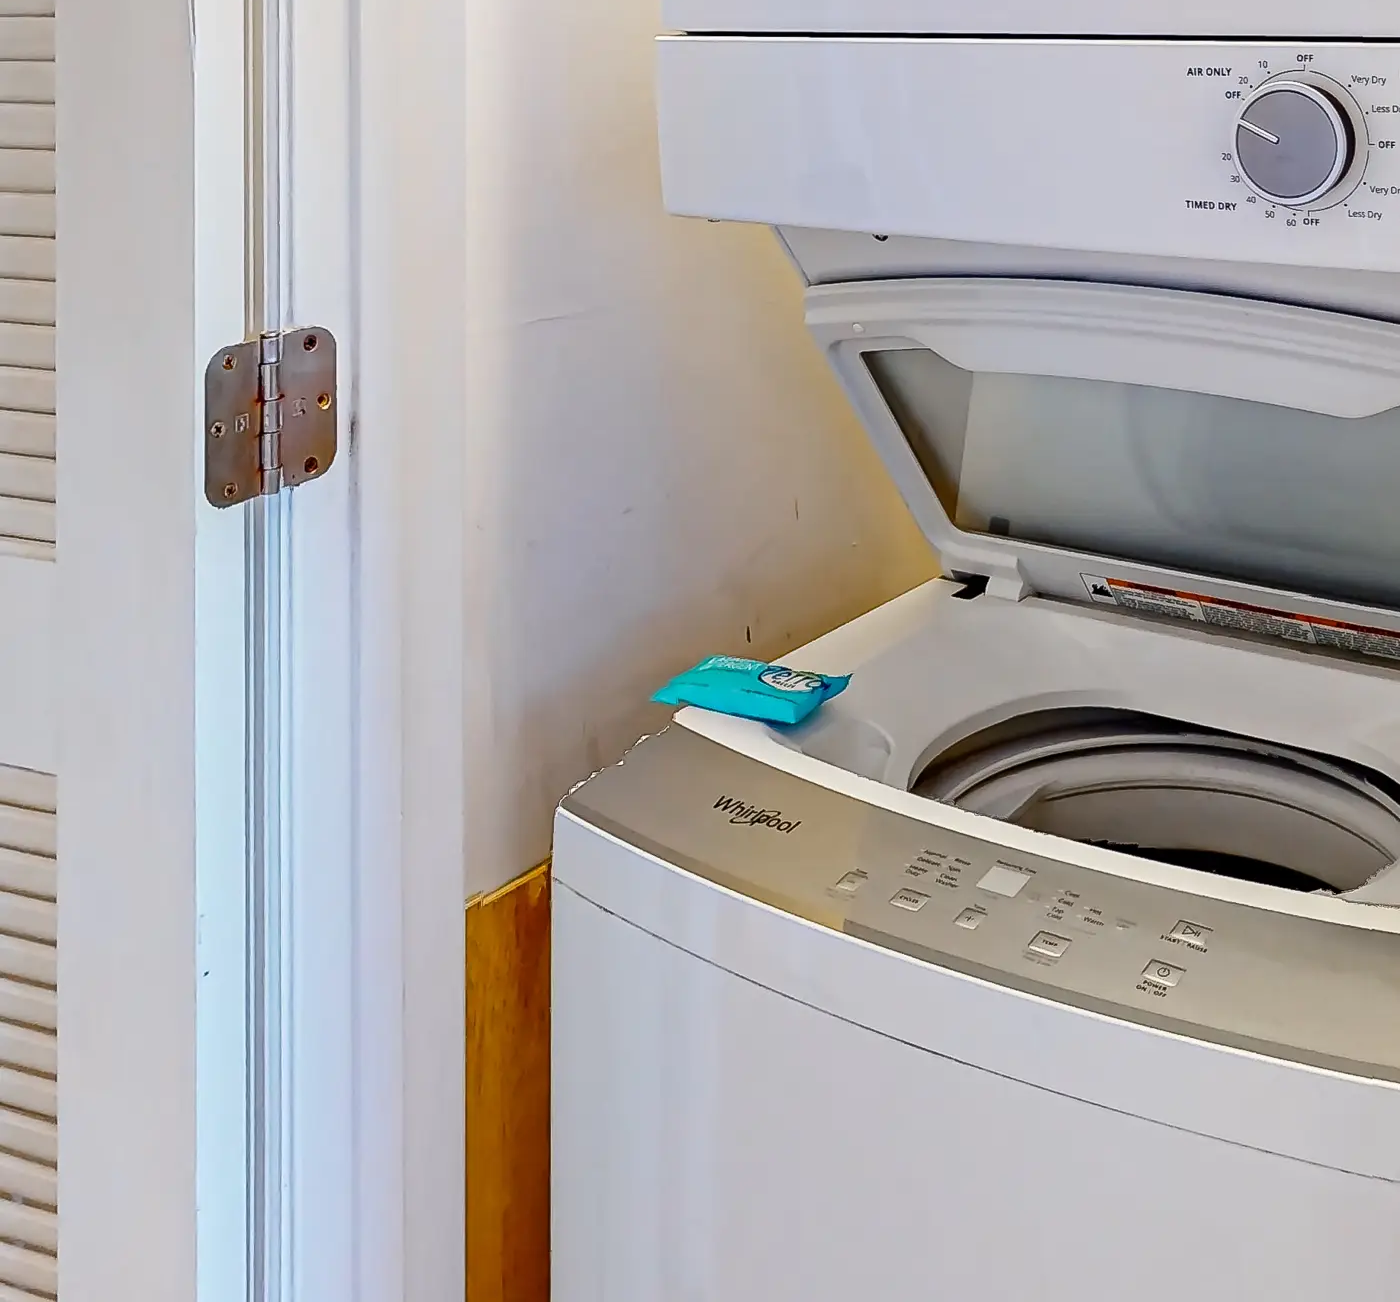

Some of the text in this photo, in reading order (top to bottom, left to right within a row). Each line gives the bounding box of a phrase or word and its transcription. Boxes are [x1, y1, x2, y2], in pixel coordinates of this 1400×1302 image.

[1296, 54, 1314, 63] OFF
[1258, 61, 1268, 69] 10
[1186, 67, 1232, 77] AIR ONLY
[1238, 77, 1249, 85] 20
[1351, 75, 1387, 86] Very Dry
[1225, 91, 1242, 100] OFF
[1371, 105, 1390, 113] Less
[1378, 141, 1396, 149] OFF
[1222, 153, 1232, 161] 20
[1230, 175, 1240, 183] 30
[1369, 185, 1389, 196] Very
[1246, 196, 1256, 204] 40
[1185, 200, 1237, 211] TIMED DRY
[1265, 210, 1275, 218] 50
[1348, 210, 1383, 220] Less Dry
[1286, 219, 1296, 227] 60
[1303, 218, 1320, 226] OFF
[713, 795, 802, 834] Whirlpool
[1143, 980, 1167, 991] POWER
[1136, 984, 1167, 998] ON OFF
